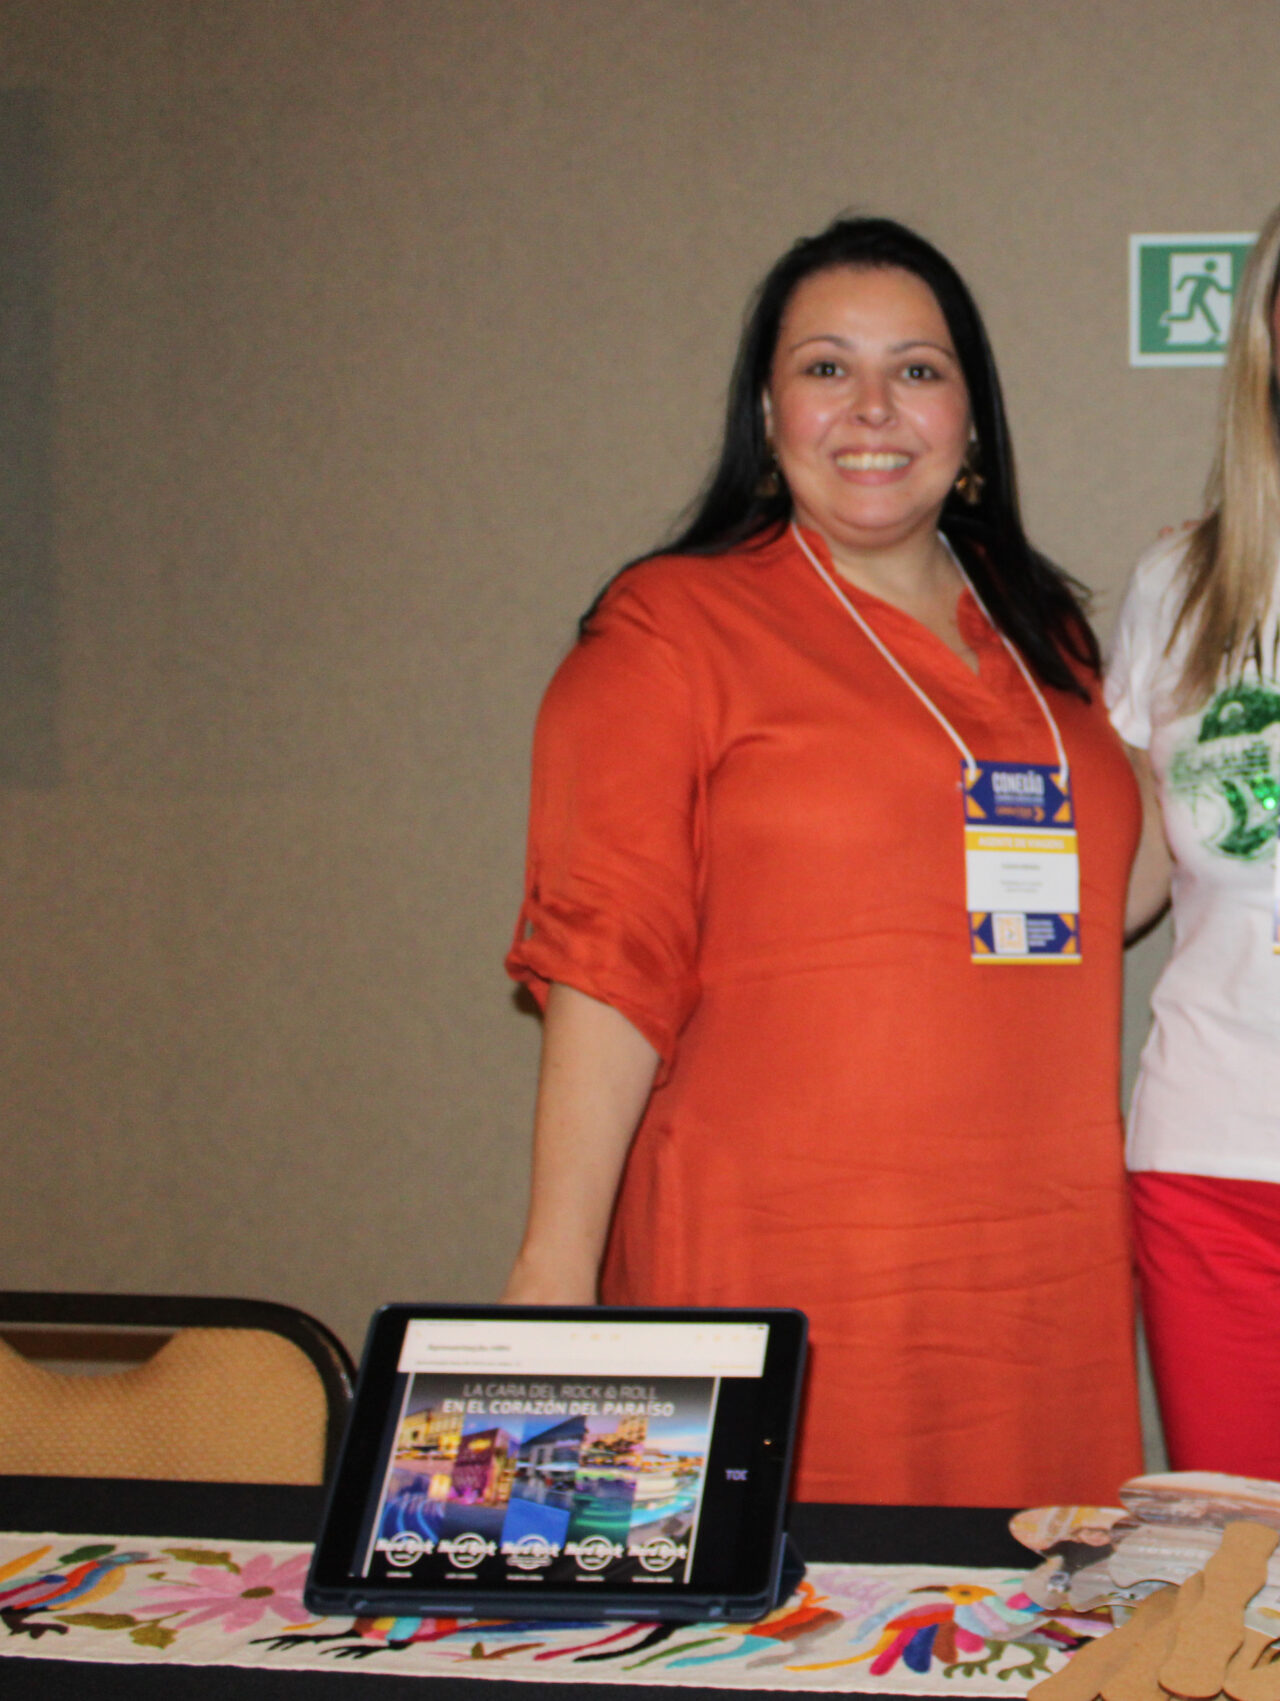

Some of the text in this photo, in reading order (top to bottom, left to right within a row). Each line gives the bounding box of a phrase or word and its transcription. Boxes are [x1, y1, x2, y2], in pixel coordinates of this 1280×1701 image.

[991, 770, 1046, 795] CONEXÃO
[462, 1384, 483, 1398] LA
[528, 1385, 555, 1399] DEL
[560, 1385, 601, 1399] ROCK
[619, 1385, 658, 1400] ROLL
[442, 1399, 675, 1417] EN EL CORAZÓN DEL PARAÍSO
